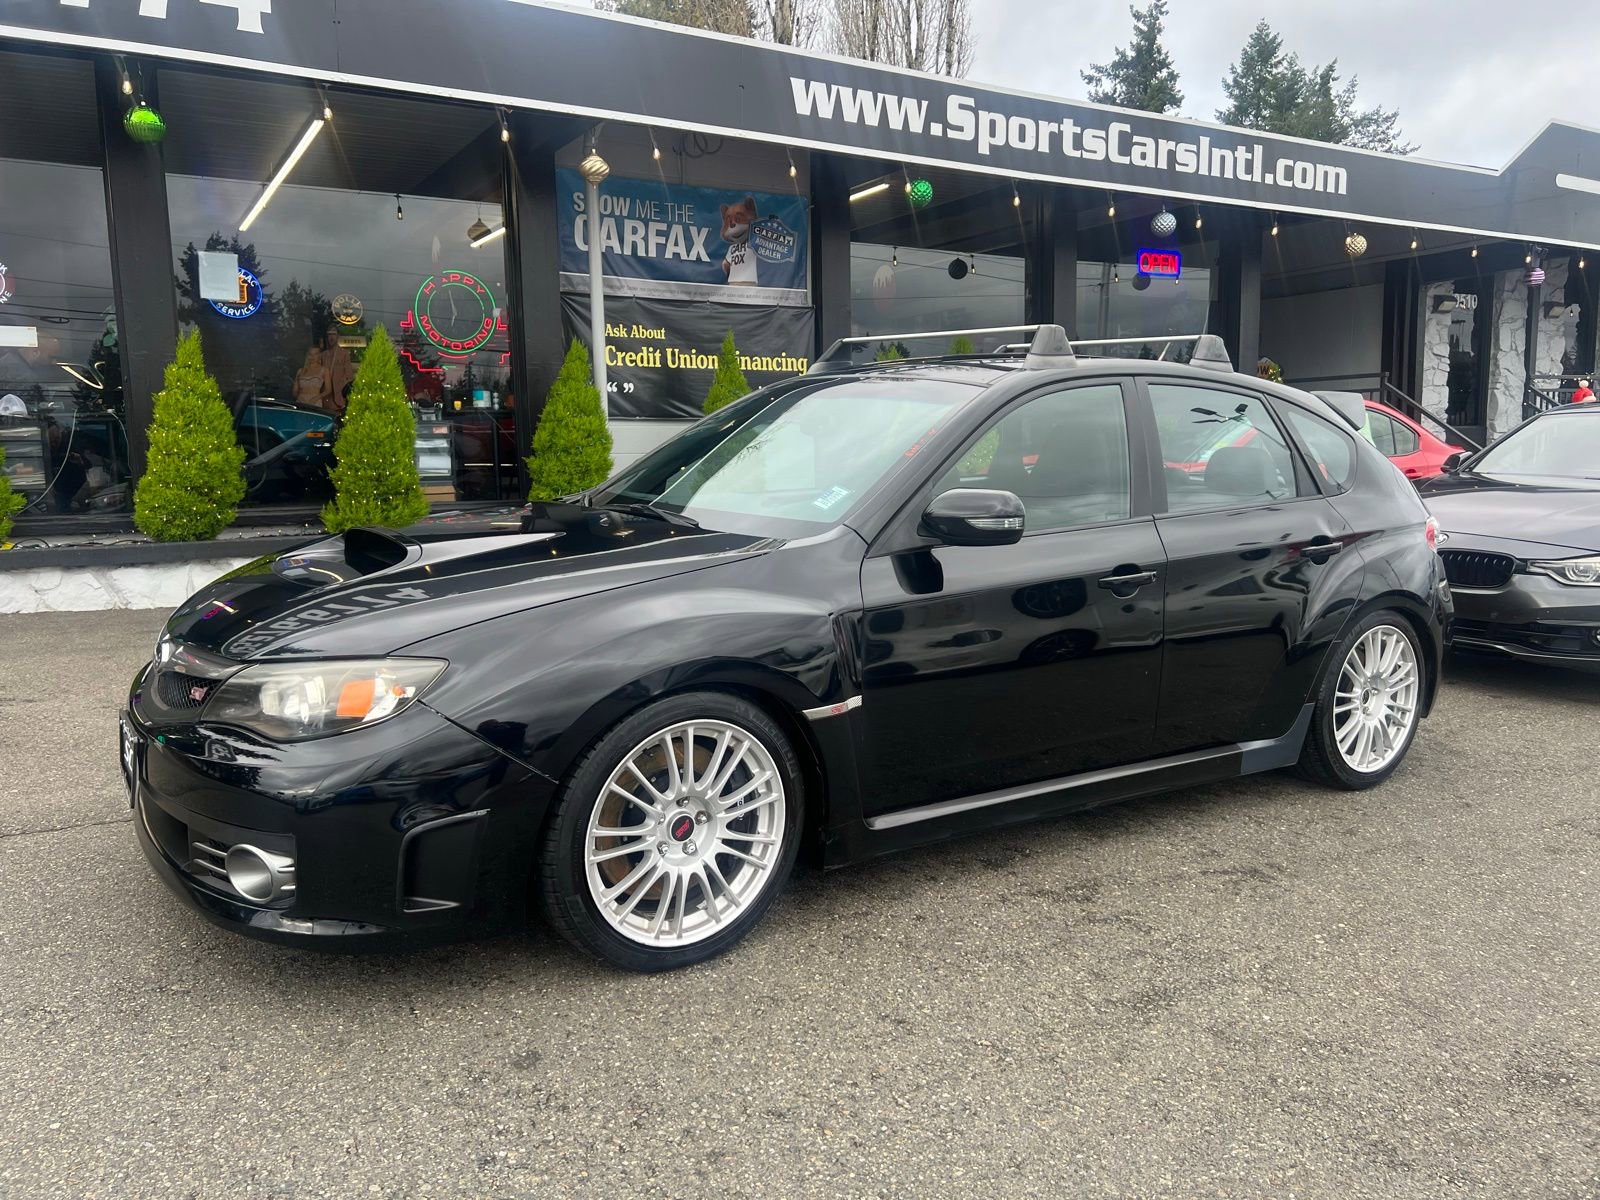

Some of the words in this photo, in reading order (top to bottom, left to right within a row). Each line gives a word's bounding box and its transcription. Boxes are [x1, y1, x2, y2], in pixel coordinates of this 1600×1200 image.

[790, 77, 1348, 196] www.SportsCarsIntl.com
[573, 191, 631, 217] SOW
[635, 199, 661, 220] ME
[664, 202, 695, 224] THE
[753, 226, 794, 247] CARFAX
[755, 237, 789, 254] ADVANTAGE
[731, 241, 747, 255] CAR
[757, 246, 781, 260] DEALER
[731, 253, 746, 266] FOX
[1140, 253, 1179, 274] OPEN
[215, 301, 256, 317] SERVICE
[420, 315, 493, 351] MOTORING
[605, 323, 629, 339] Ask
[630, 324, 666, 340] About
[605, 344, 662, 369] Credit
[665, 346, 719, 370] Union
[735, 350, 808, 376] inancing
